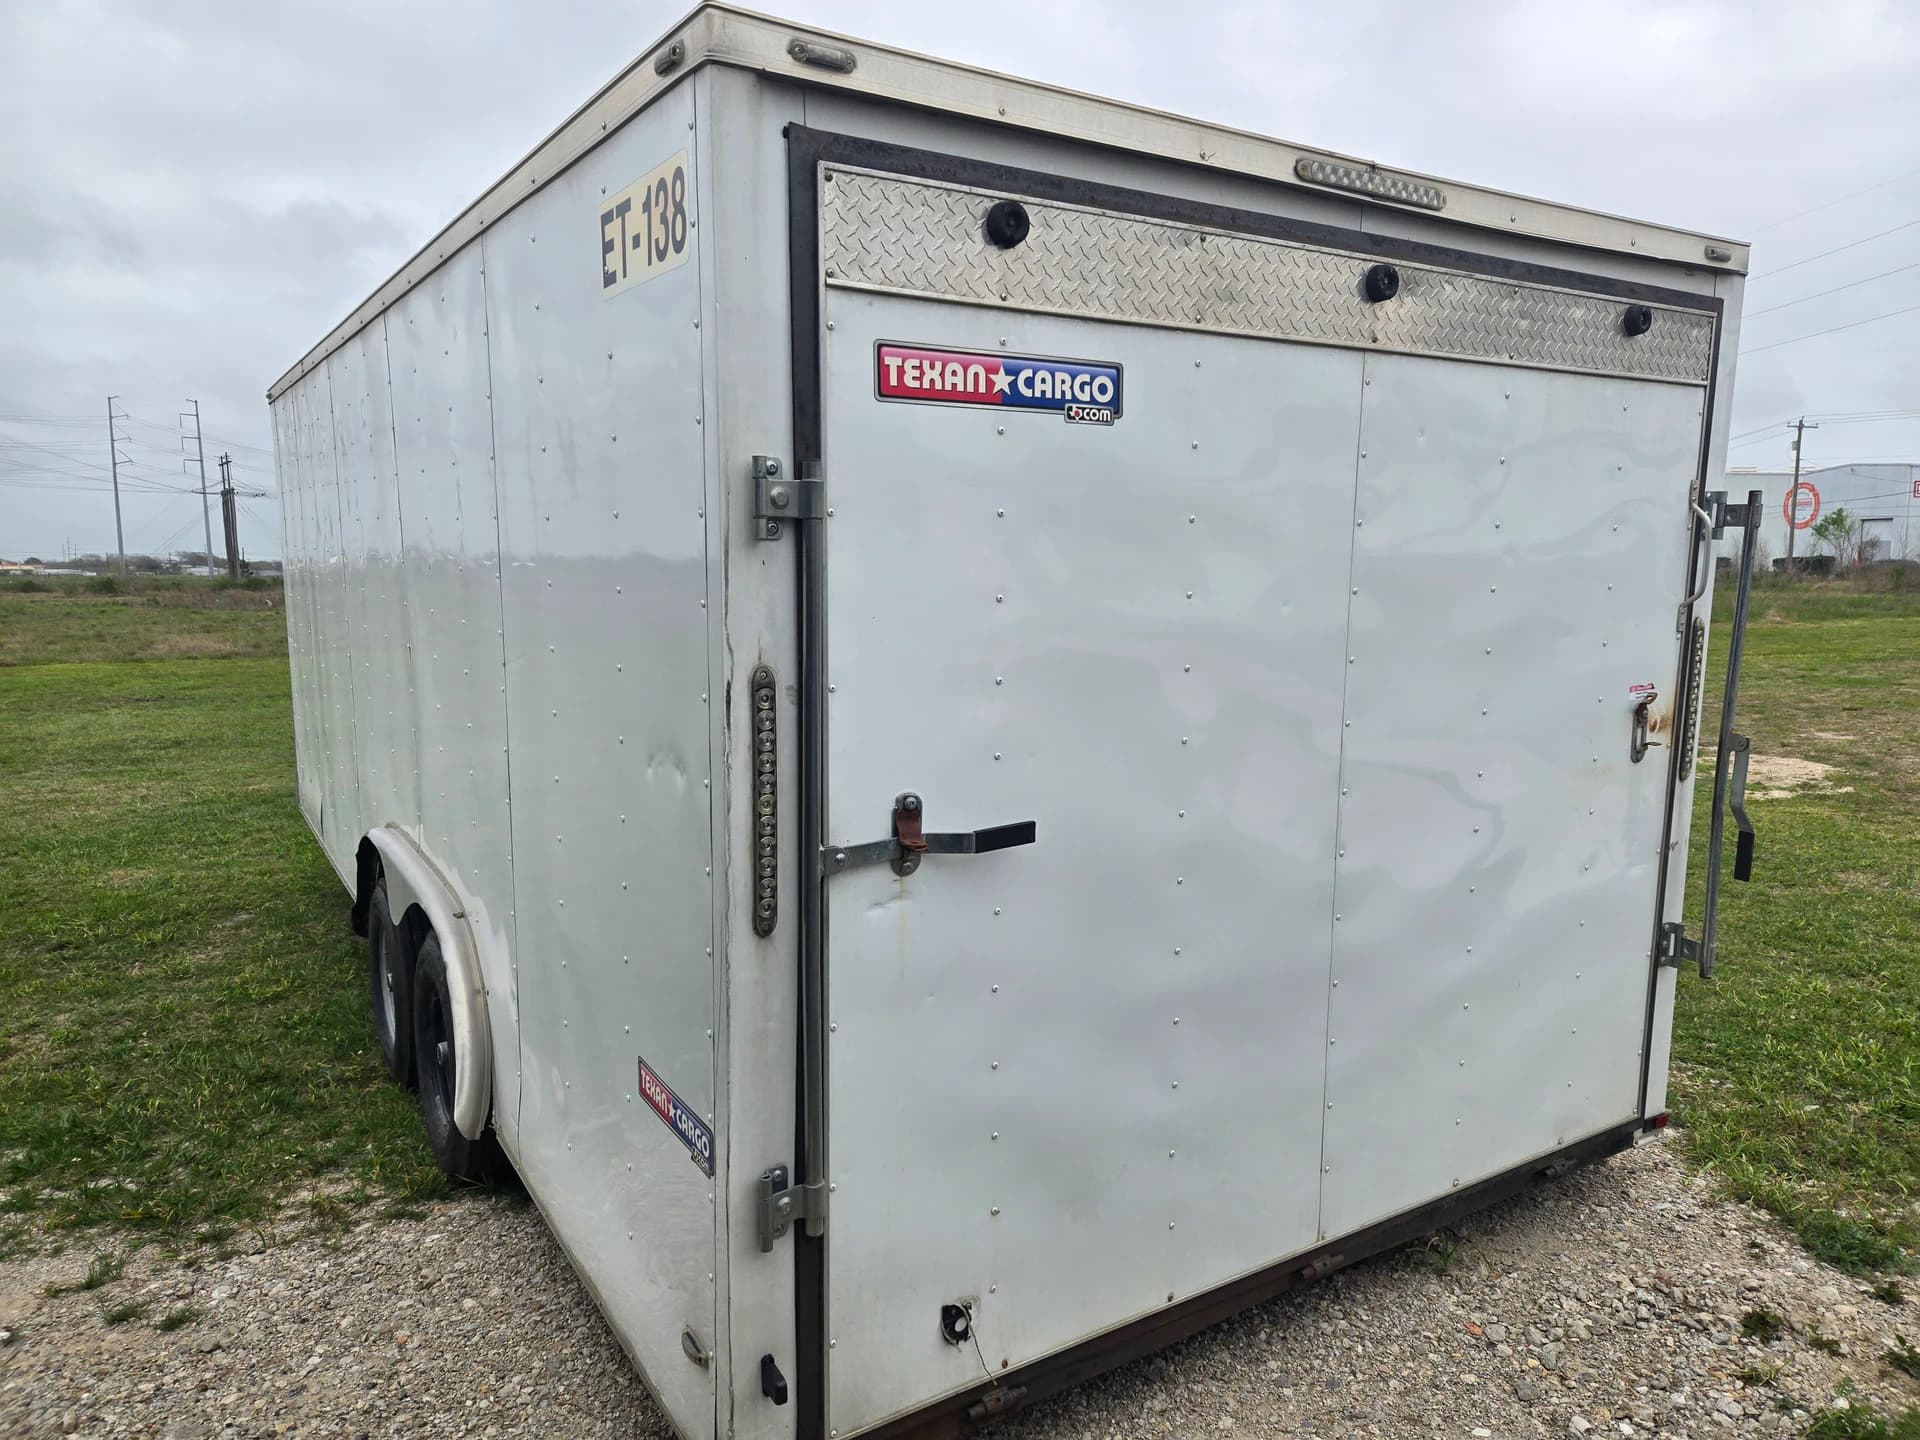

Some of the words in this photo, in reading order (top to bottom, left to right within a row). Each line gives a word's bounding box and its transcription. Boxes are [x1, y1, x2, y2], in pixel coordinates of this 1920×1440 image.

[601, 166, 687, 289] ET-138
[884, 356, 987, 394] TEXAN
[1017, 368, 1114, 403] CARGO
[640, 1069, 668, 1113] TEXAN
[676, 1109, 710, 1158] CARGO
